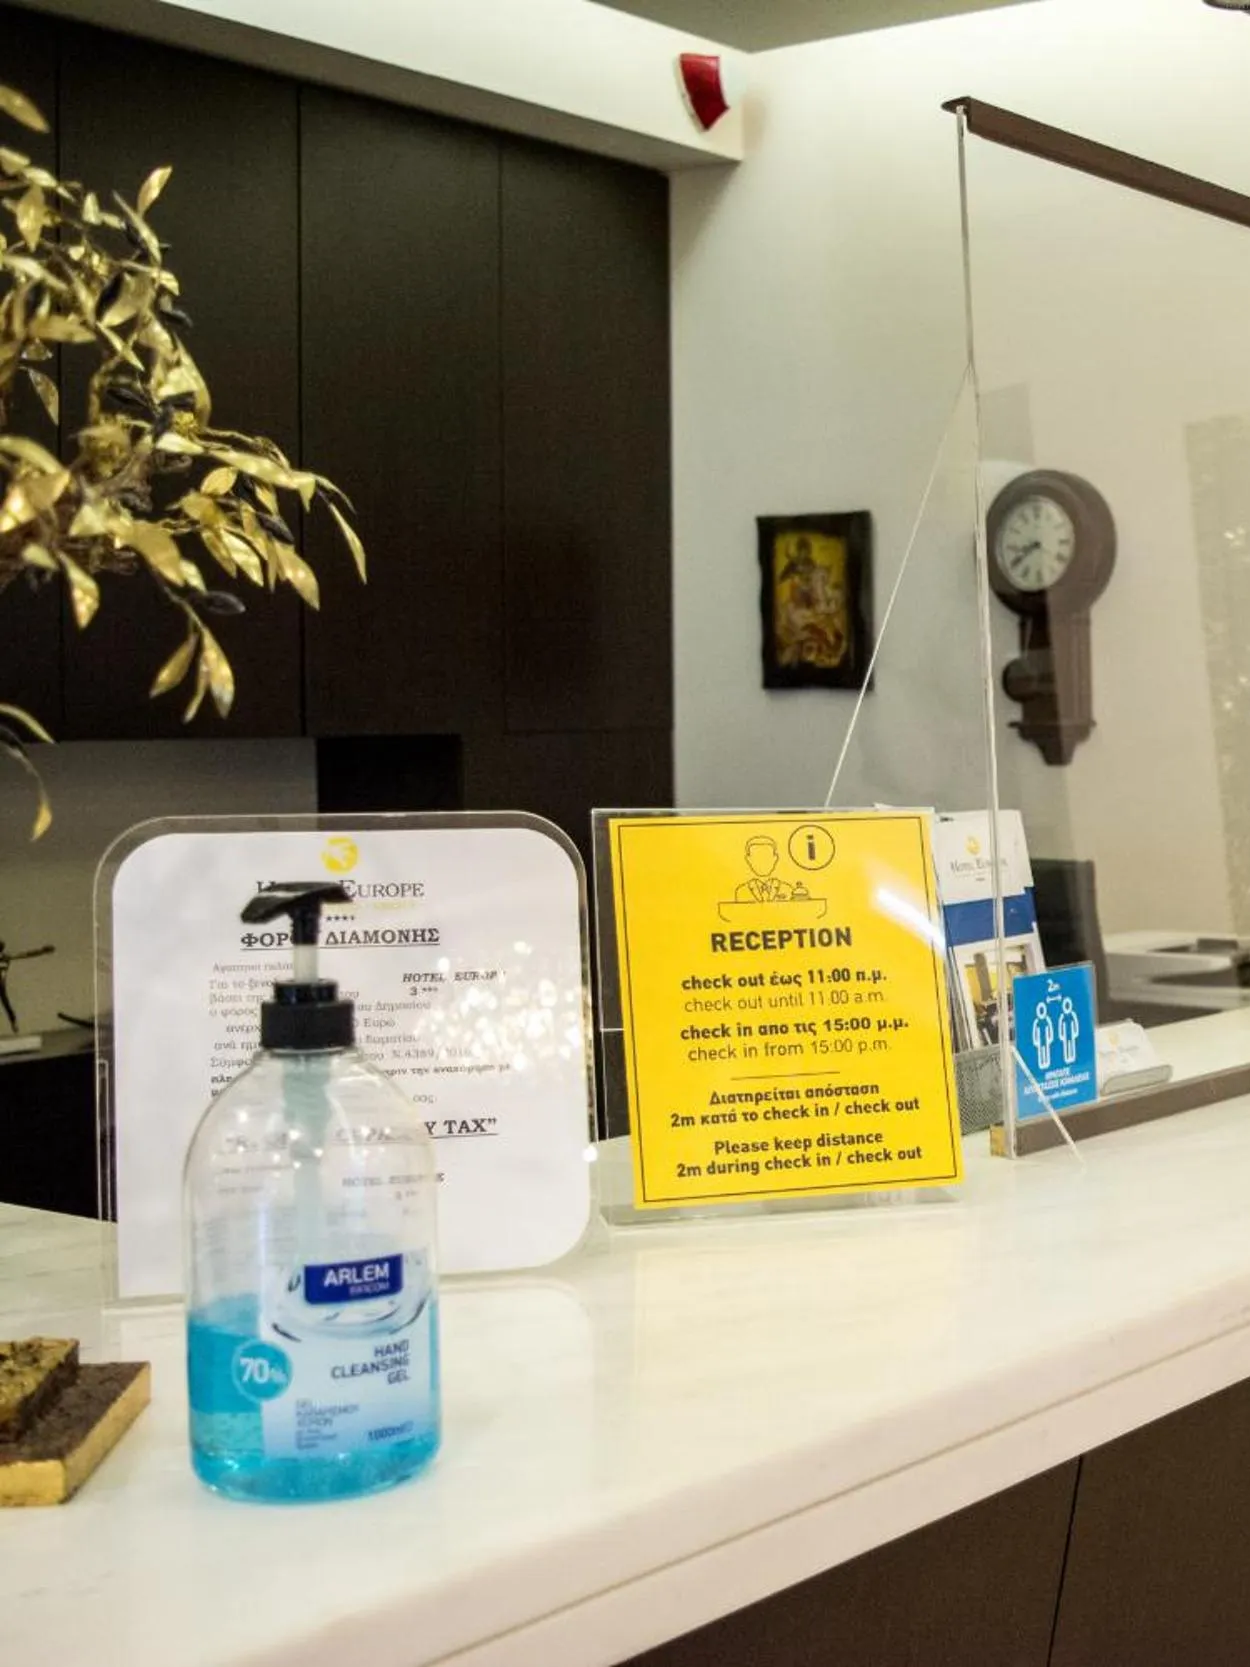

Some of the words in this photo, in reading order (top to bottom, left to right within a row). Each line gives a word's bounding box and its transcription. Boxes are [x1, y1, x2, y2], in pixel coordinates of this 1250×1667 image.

[241, 931, 296, 948] ΦΟΡ
[325, 927, 440, 946] ΔΙΑΜΟΝΗΣ
[711, 927, 853, 952] RECEPTION
[402, 971, 446, 983] HOTEL
[453, 970, 501, 981] EURP
[682, 973, 733, 990] check
[738, 973, 765, 988] out
[770, 970, 802, 987] έως
[808, 967, 851, 983] 11:00
[684, 996, 733, 1012] check
[737, 995, 763, 1010] out
[769, 991, 803, 1008] until
[680, 1022, 731, 1040] check
[737, 1021, 753, 1037] in
[824, 1016, 872, 1032] 15:00
[688, 1043, 737, 1061] check
[743, 1042, 758, 1058] in
[764, 1039, 805, 1056] from
[811, 1037, 854, 1053] 15:00
[709, 1088, 801, 1106] Διατηρείται
[671, 1112, 695, 1127] 2m
[700, 1109, 737, 1125] κατά
[743, 1108, 760, 1122] το
[763, 1104, 811, 1121] check
[815, 1103, 830, 1118] in
[834, 1101, 841, 1116] /
[845, 1099, 891, 1116] check
[896, 1097, 920, 1111] out
[714, 1138, 770, 1155] Please
[774, 1135, 813, 1152] keep
[816, 1131, 884, 1148] distance
[677, 1162, 701, 1178] 2m
[706, 1158, 760, 1176] during
[765, 1152, 812, 1171] check
[816, 1151, 831, 1167] in
[836, 1150, 842, 1165] /
[847, 1147, 894, 1165] check
[898, 1146, 923, 1160] out
[323, 1261, 390, 1287] ARLEM
[374, 1339, 411, 1357] HAND
[330, 1353, 411, 1379] CLEANSING
[387, 1369, 411, 1384] GEL
